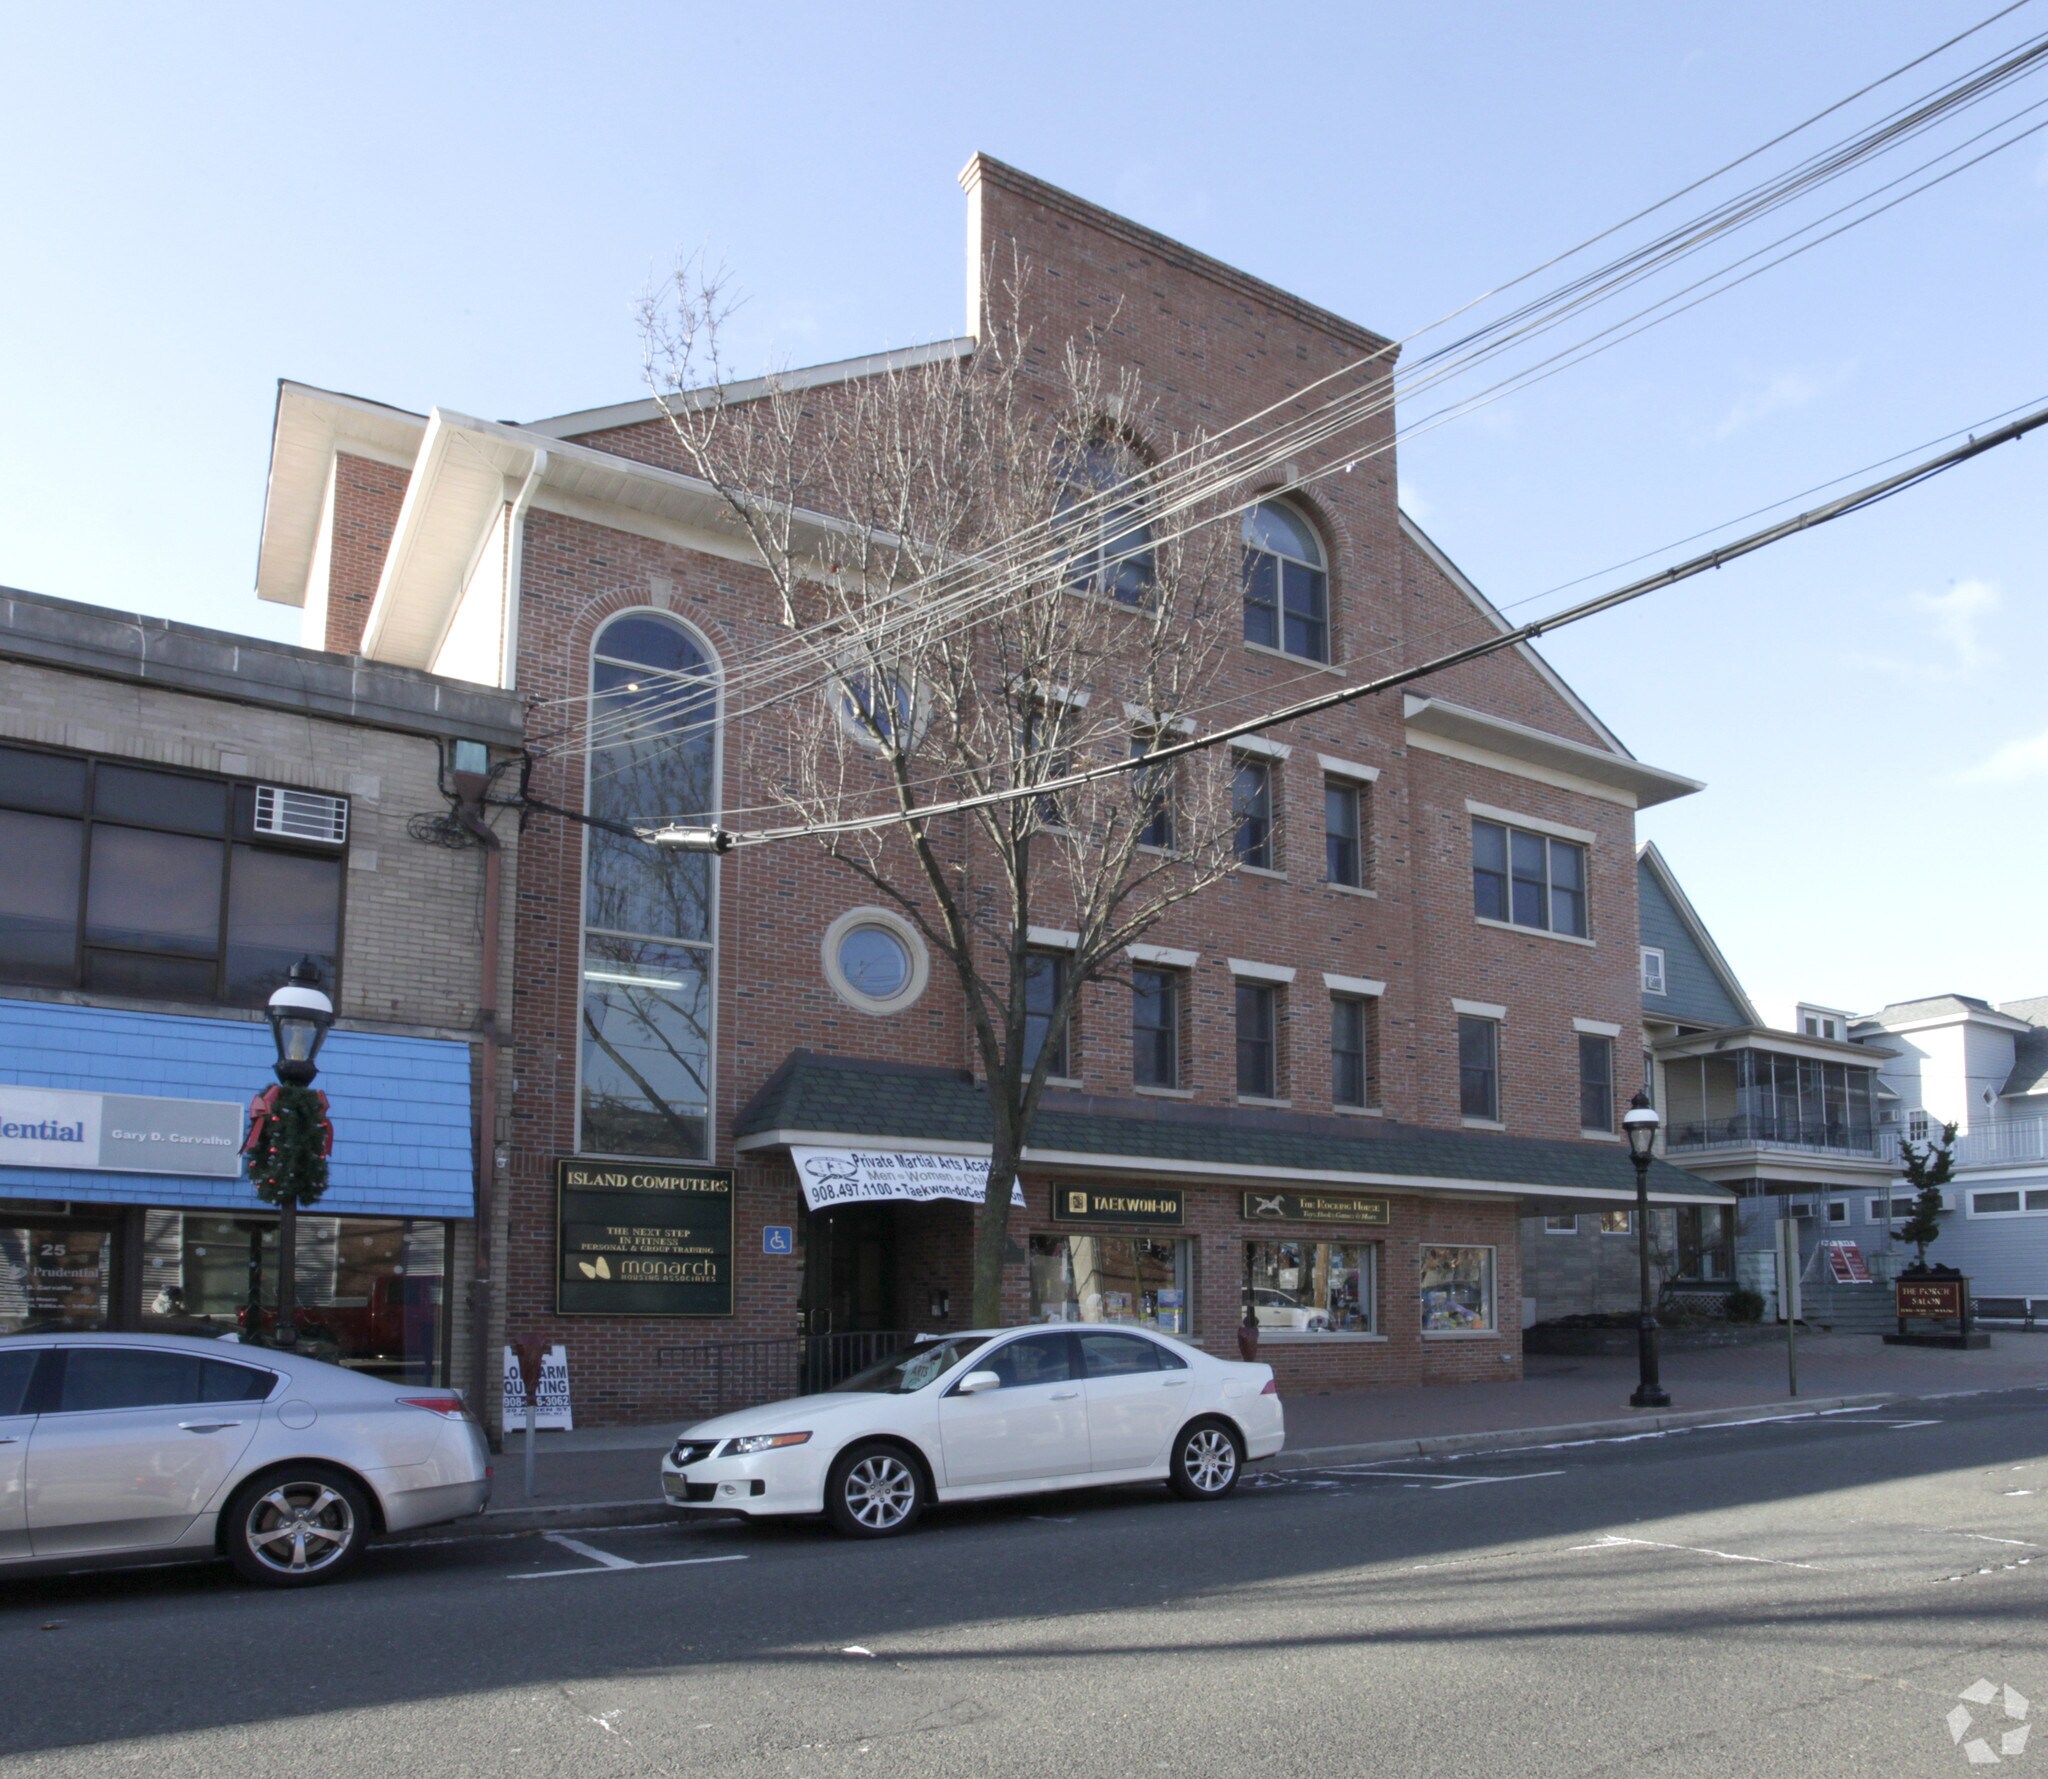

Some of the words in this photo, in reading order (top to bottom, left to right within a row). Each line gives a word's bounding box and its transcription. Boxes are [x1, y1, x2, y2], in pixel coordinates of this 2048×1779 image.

[0, 1116, 85, 1143] ential
[111, 1129, 147, 1143] Gary
[151, 1132, 165, 1142] D.
[169, 1133, 232, 1146] Carvalho
[852, 1153, 895, 1168] Private
[895, 1154, 936, 1169] Martial
[939, 1156, 963, 1171] Arts
[964, 1158, 992, 1173] Acad
[567, 1171, 628, 1188] ISLAND
[631, 1175, 729, 1193] COMPUTERS
[866, 1170, 896, 1182] Men
[905, 1170, 954, 1183] Women
[964, 1173, 987, 1187] Chil
[811, 1183, 893, 1203] 908.497.1100
[1092, 1196, 1177, 1214] TAEKWON-DO
[607, 1227, 629, 1235] THE
[632, 1227, 661, 1237] NEXT
[665, 1229, 691, 1238] STEP
[581, 1243, 627, 1251] PERSONAL
[630, 1244, 637, 1252] &
[640, 1245, 670, 1253] GROUP
[673, 1246, 714, 1254] TRAINING
[620, 1236, 631, 1244] IN
[635, 1237, 678, 1246] FITNESS
[41, 1244, 66, 1256] 25
[33, 1267, 99, 1278] Prudential
[621, 1259, 716, 1276] monarch
[1902, 1287, 1916, 1295] THE
[1919, 1287, 1950, 1295] PORCH
[1911, 1297, 1941, 1305] SALON
[504, 1380, 567, 1395] QUTING
[504, 1396, 569, 1407] 908-6-3062
